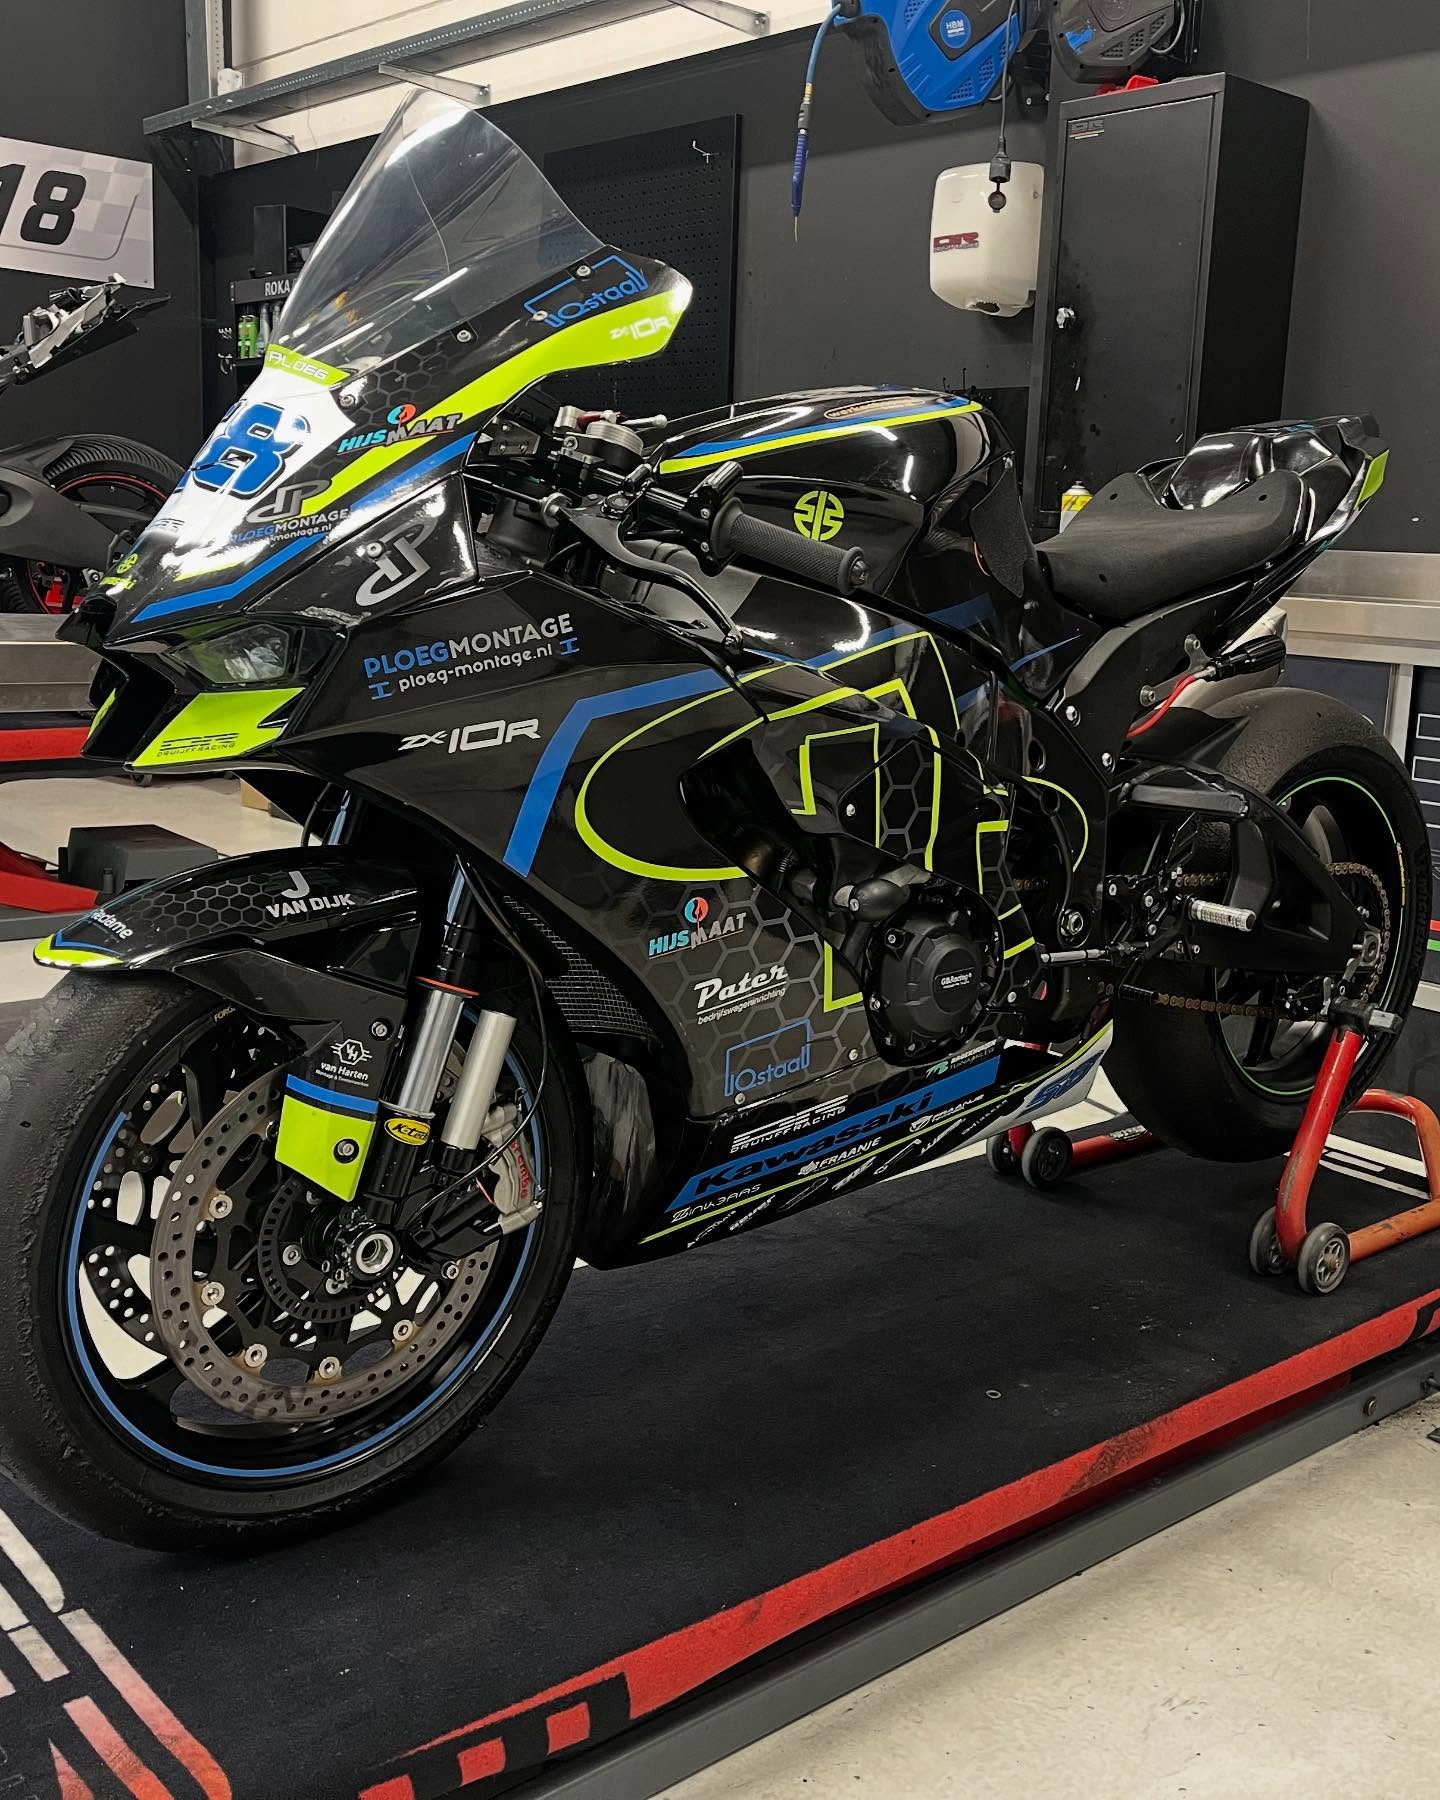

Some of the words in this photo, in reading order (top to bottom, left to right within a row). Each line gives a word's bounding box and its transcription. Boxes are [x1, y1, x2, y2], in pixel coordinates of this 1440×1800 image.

[266, 350, 330, 380] PLOEG
[337, 413, 463, 453] HIJSMAAT
[363, 612, 574, 679] PLOEGMONTAGE
[398, 643, 553, 693] ploeg-montage.nl
[266, 901, 308, 918] VAN
[313, 893, 356, 910] DIJK
[648, 912, 747, 957] HIJSMAAT
[693, 964, 789, 1009] Pater
[320, 1061, 337, 1073] van
[338, 1065, 369, 1081] Harten
[726, 1043, 810, 1096] IQstaal
[694, 1090, 934, 1197] Kawasaki
[819, 1136, 882, 1168] FRAANJE
